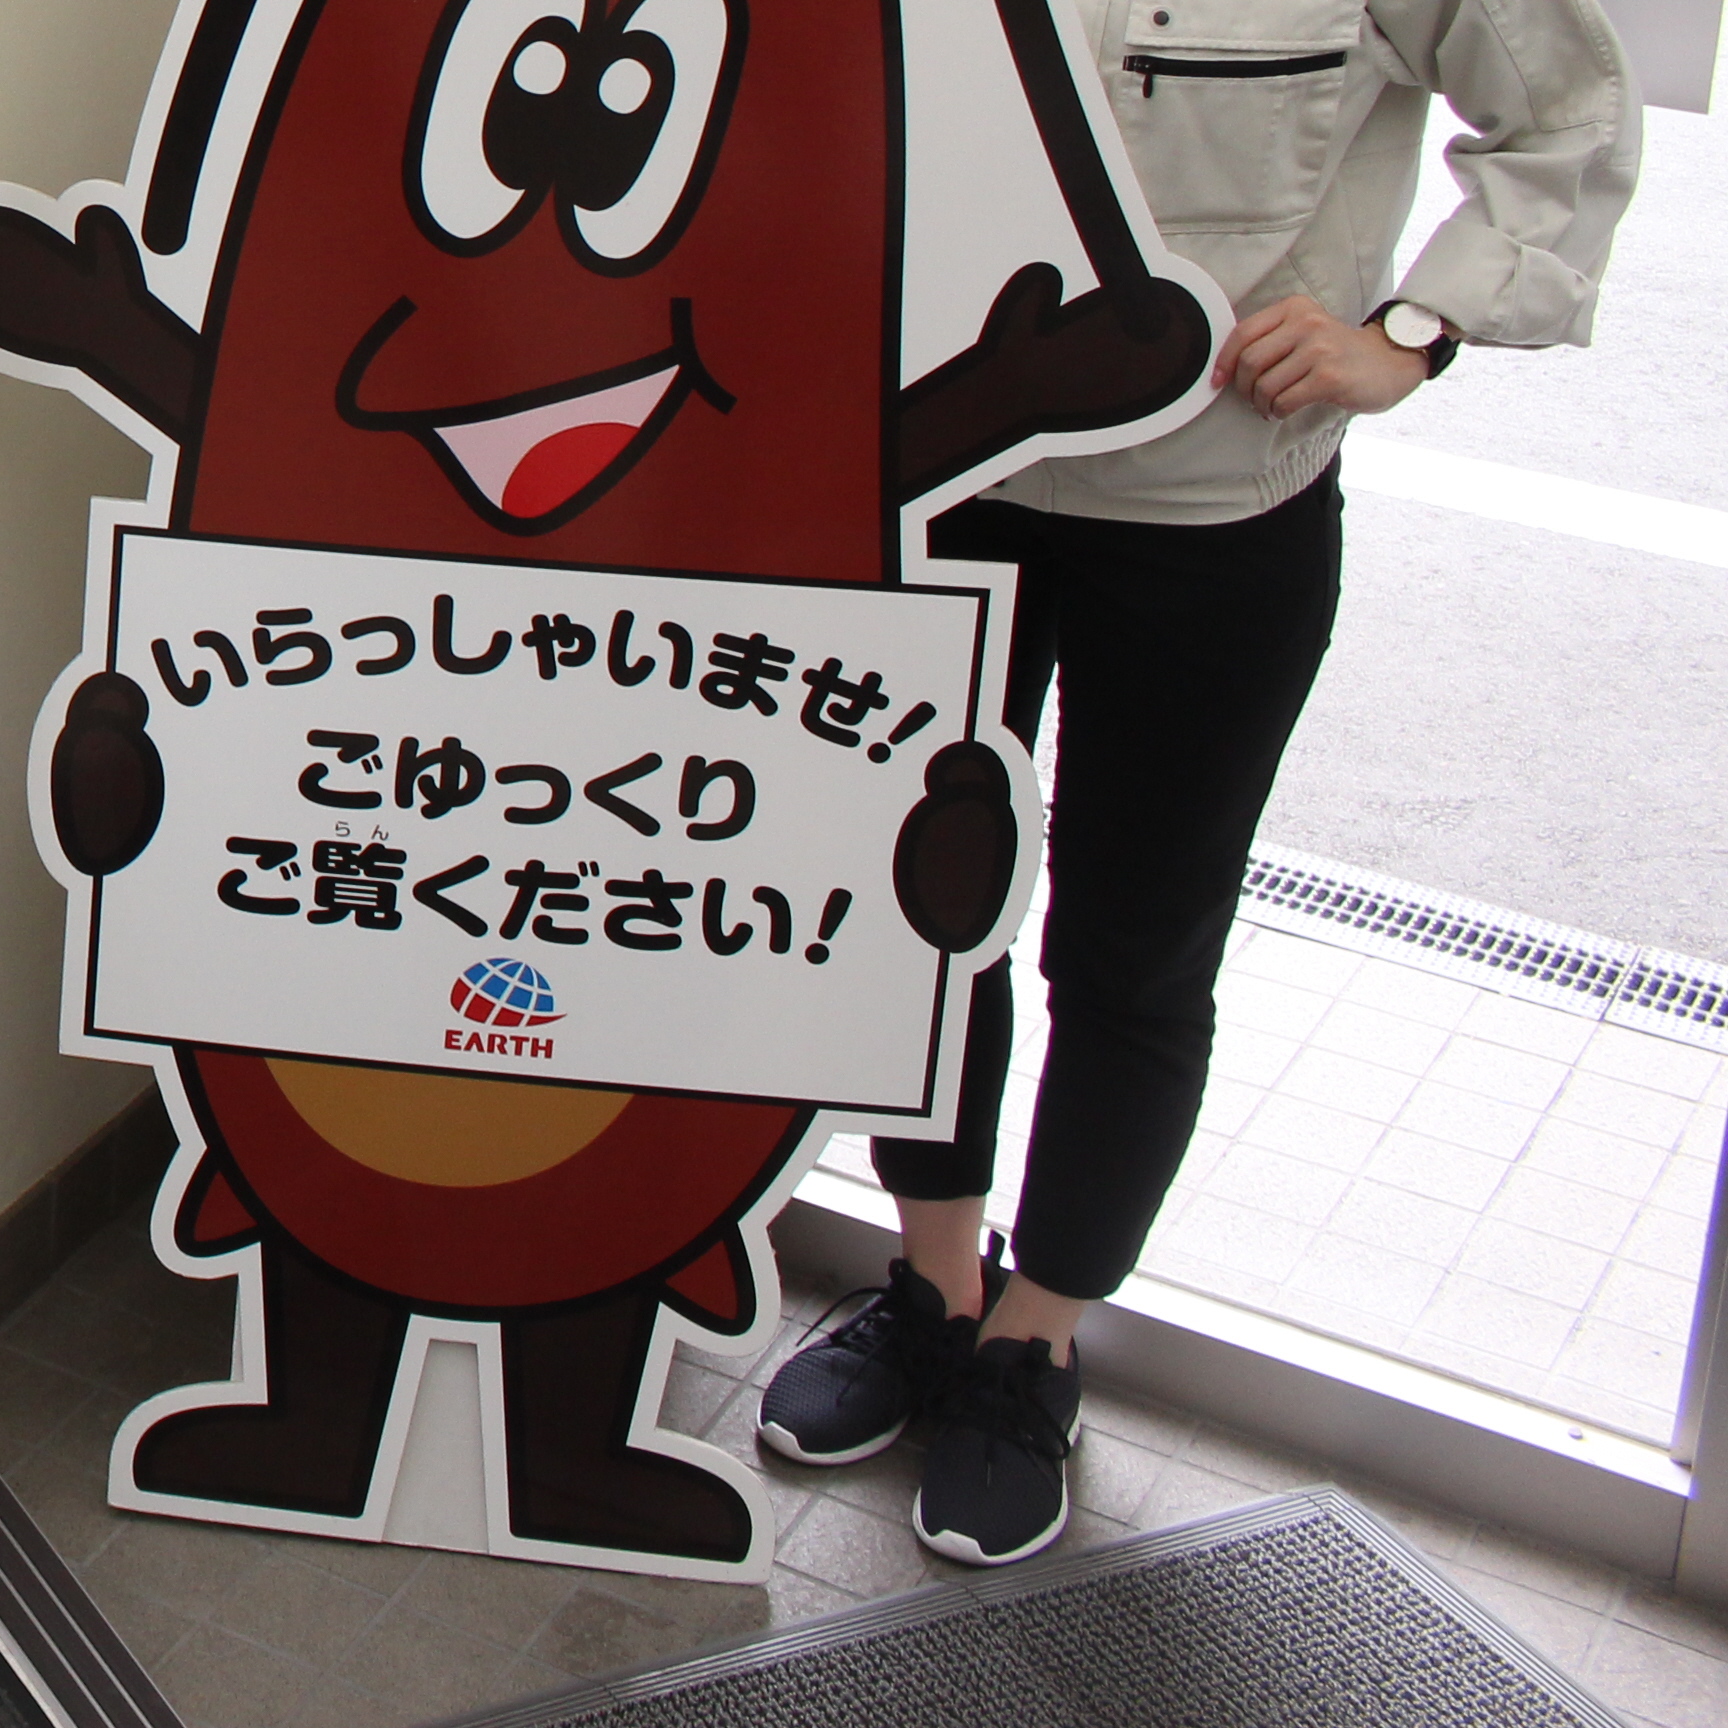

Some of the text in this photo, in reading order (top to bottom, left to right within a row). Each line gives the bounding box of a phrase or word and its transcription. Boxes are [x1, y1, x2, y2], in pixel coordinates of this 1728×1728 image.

[151, 593, 939, 765] いらっしゃいませ!
[296, 727, 758, 841] ごゆっくり
[217, 835, 854, 965] ご覧ください!
[443, 1027, 555, 1060] EARTH
